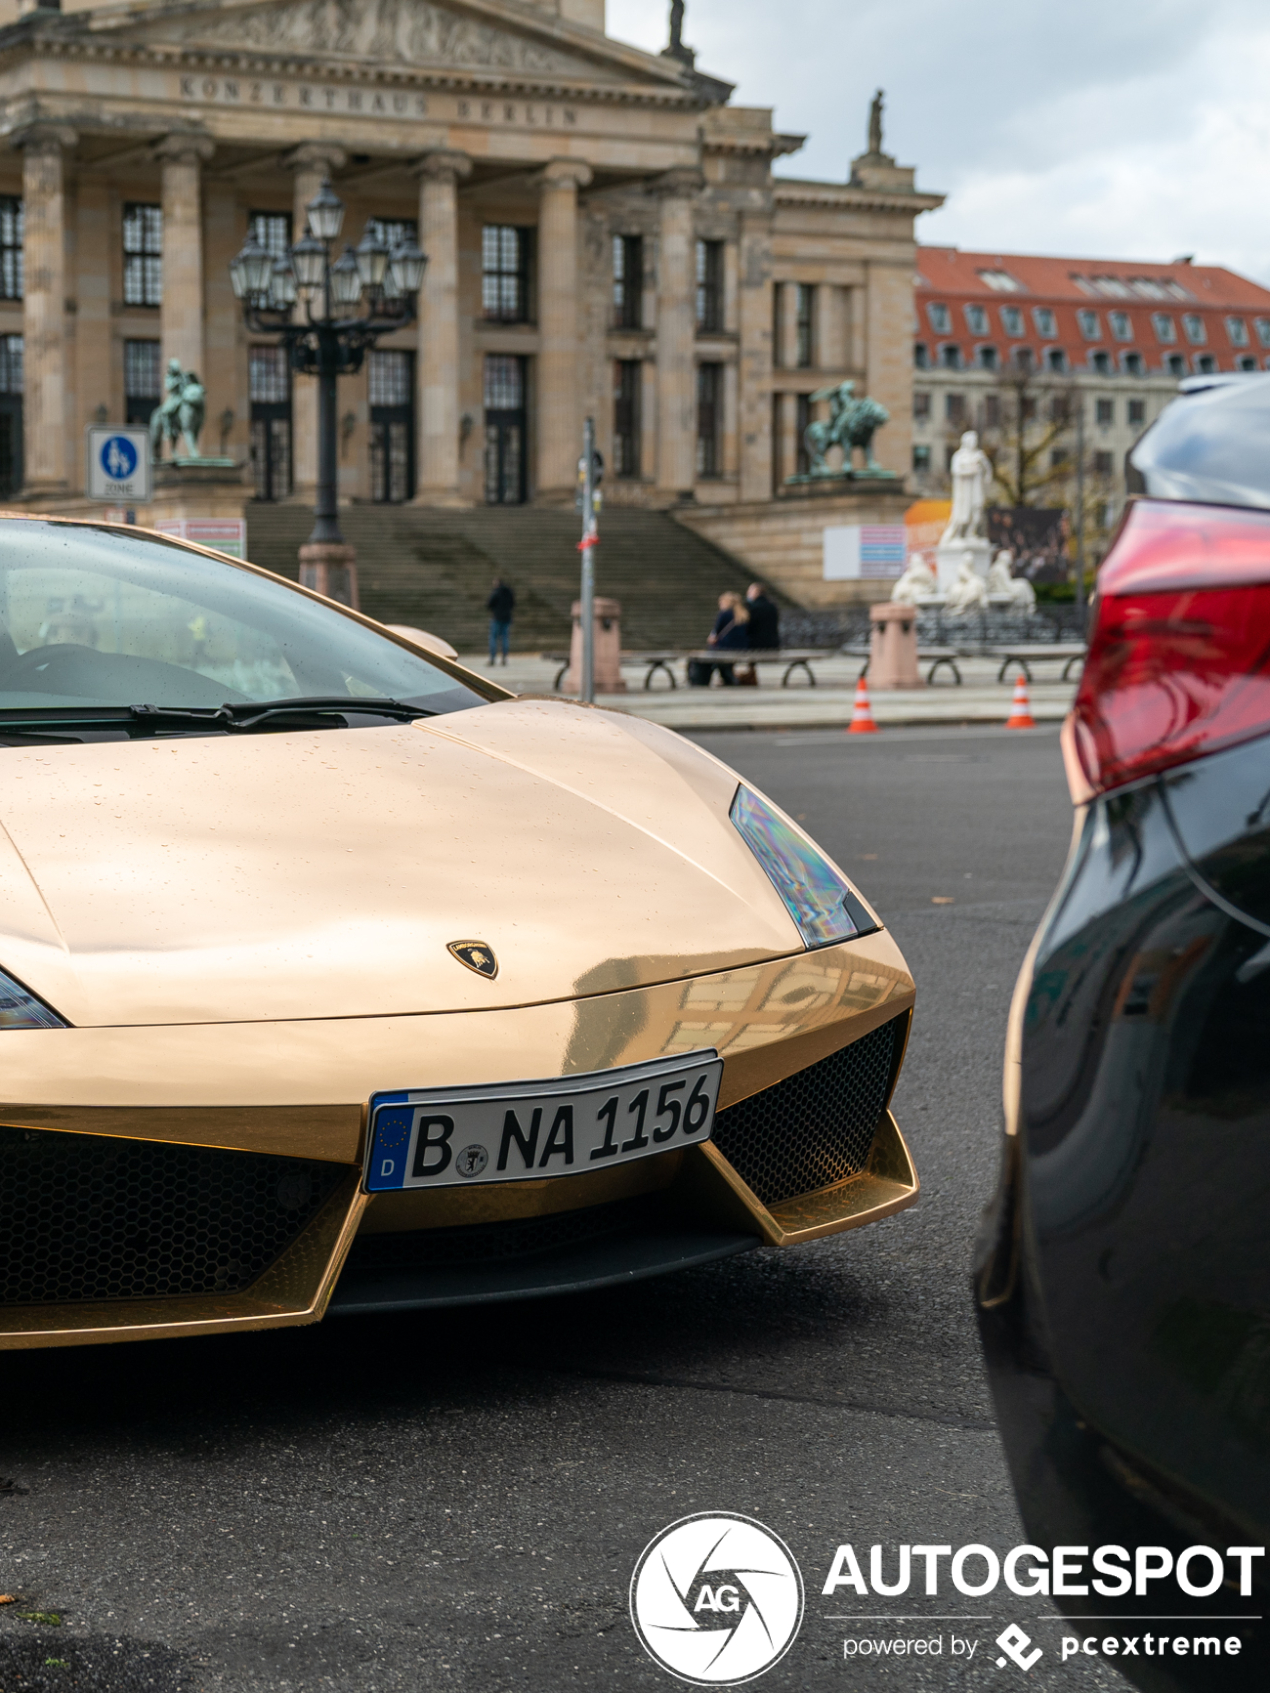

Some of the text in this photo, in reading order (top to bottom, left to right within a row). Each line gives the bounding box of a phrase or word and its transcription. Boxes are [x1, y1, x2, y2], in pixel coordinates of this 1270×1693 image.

[179, 76, 579, 126] KONZERTHAUS BERLIN
[104, 483, 134, 496] ZONE
[411, 1074, 711, 1178] B NA 1156
[380, 1159, 394, 1177] D
